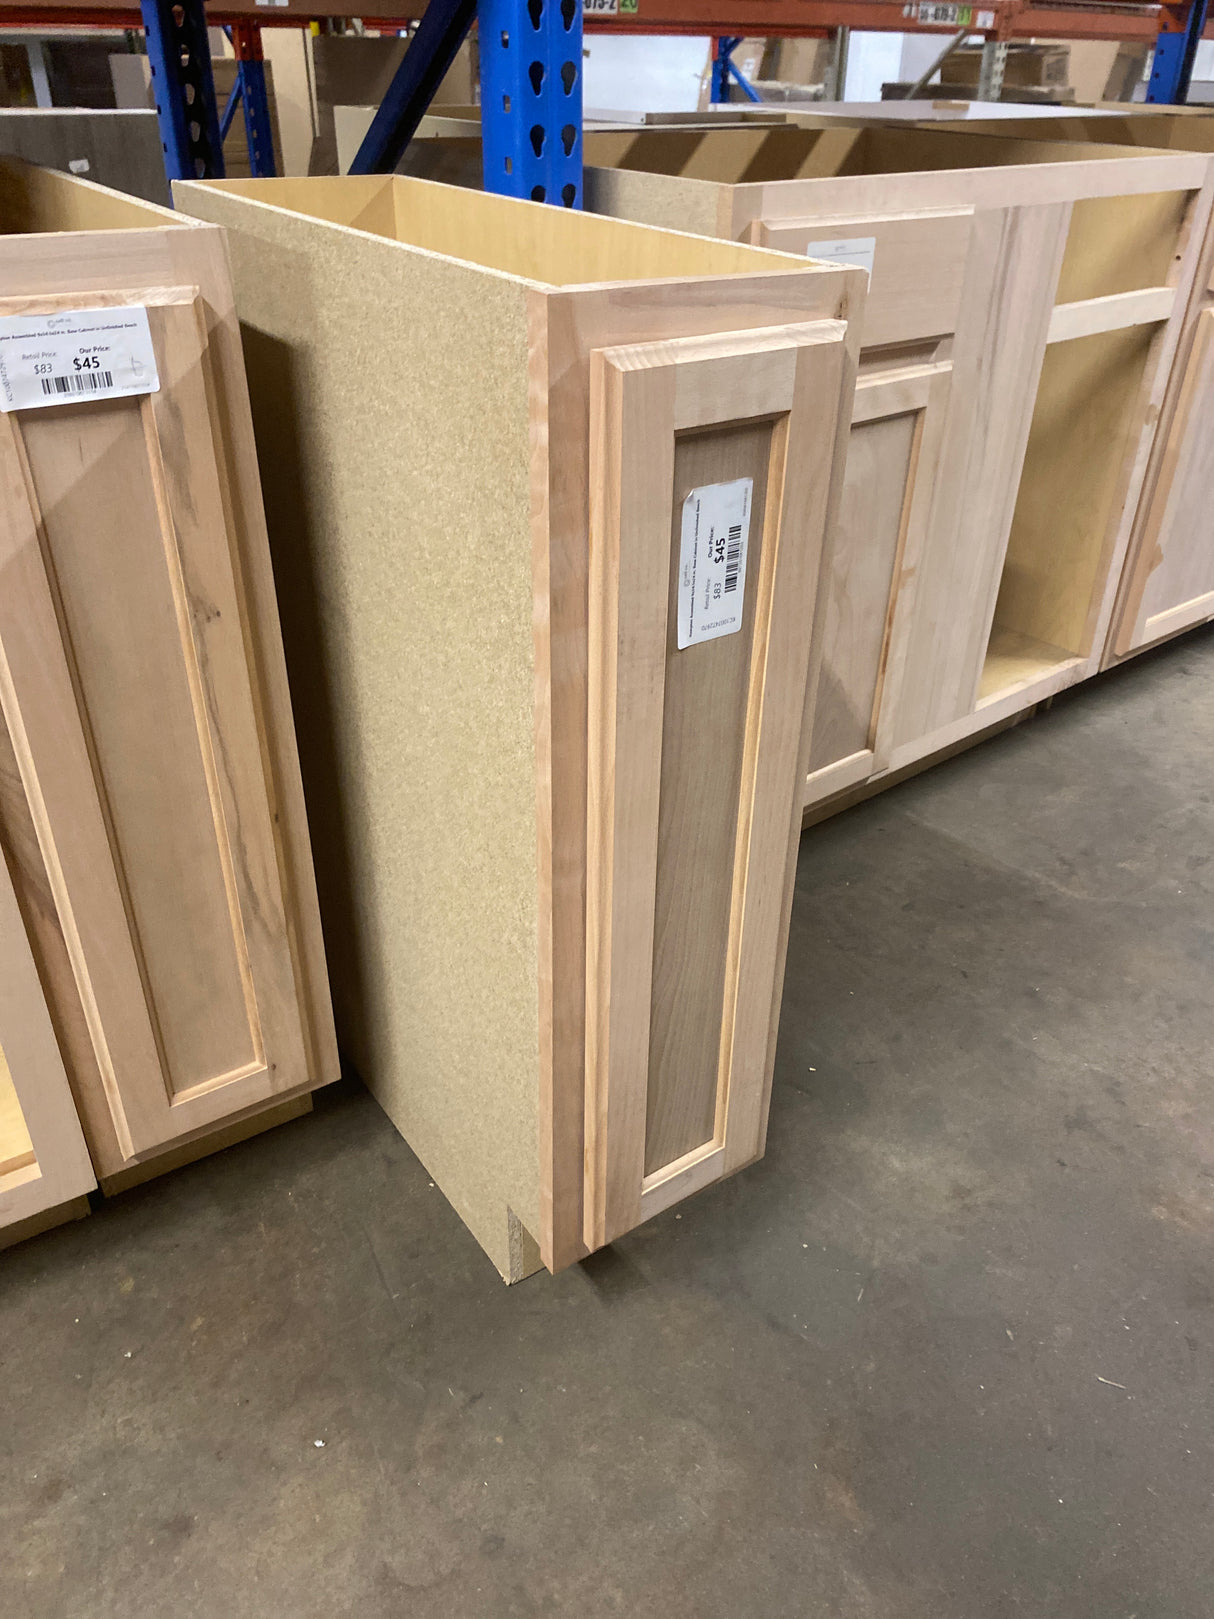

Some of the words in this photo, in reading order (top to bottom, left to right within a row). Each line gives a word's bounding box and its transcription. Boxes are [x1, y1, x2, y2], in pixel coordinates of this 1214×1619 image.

[21, 353, 40, 361] Retail
[79, 347, 92, 355] Our
[93, 345, 111, 353] Price:
[34, 362, 53, 375] $83
[73, 355, 100, 371] $45
[714, 537, 726, 564] $45
[713, 582, 722, 600] $83
